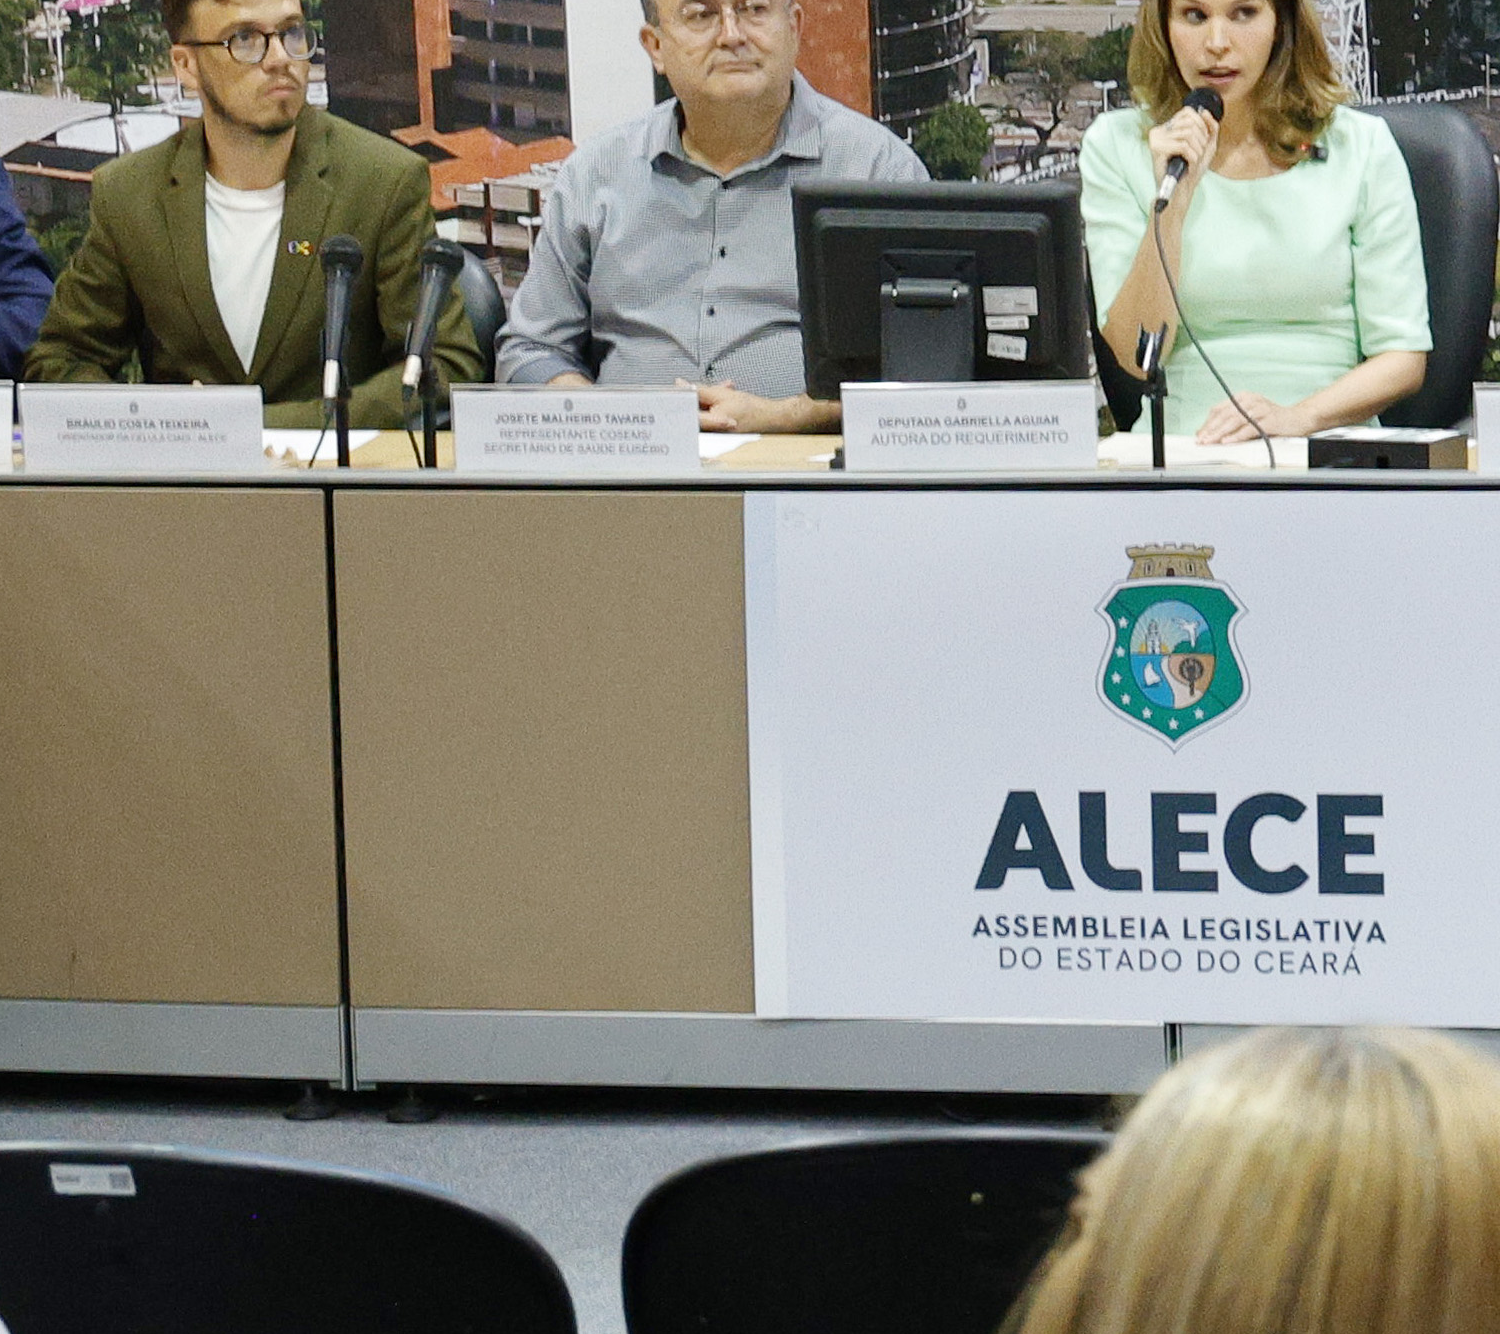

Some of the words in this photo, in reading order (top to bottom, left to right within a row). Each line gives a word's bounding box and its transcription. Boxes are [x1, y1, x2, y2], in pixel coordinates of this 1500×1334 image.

[159, 418, 210, 429] TEIXEIRA
[605, 413, 656, 425] TAVARES
[878, 416, 941, 428] DEPUTADA
[944, 415, 1011, 427] GABRIELLA
[499, 428, 596, 440] REPRESENTANTE
[870, 432, 928, 446] AUTORA
[930, 432, 951, 445] DO
[955, 430, 1069, 445] REQUERIMENTO
[974, 789, 1385, 895] ALECE
[972, 914, 1170, 940] ASSEMBLEIA
[1183, 917, 1387, 944] LEGISLATIVA
[999, 946, 1042, 970] DO
[1057, 947, 1182, 973] ESTADO
[1198, 949, 1240, 974] DO
[1254, 943, 1362, 976] CEARÁ
